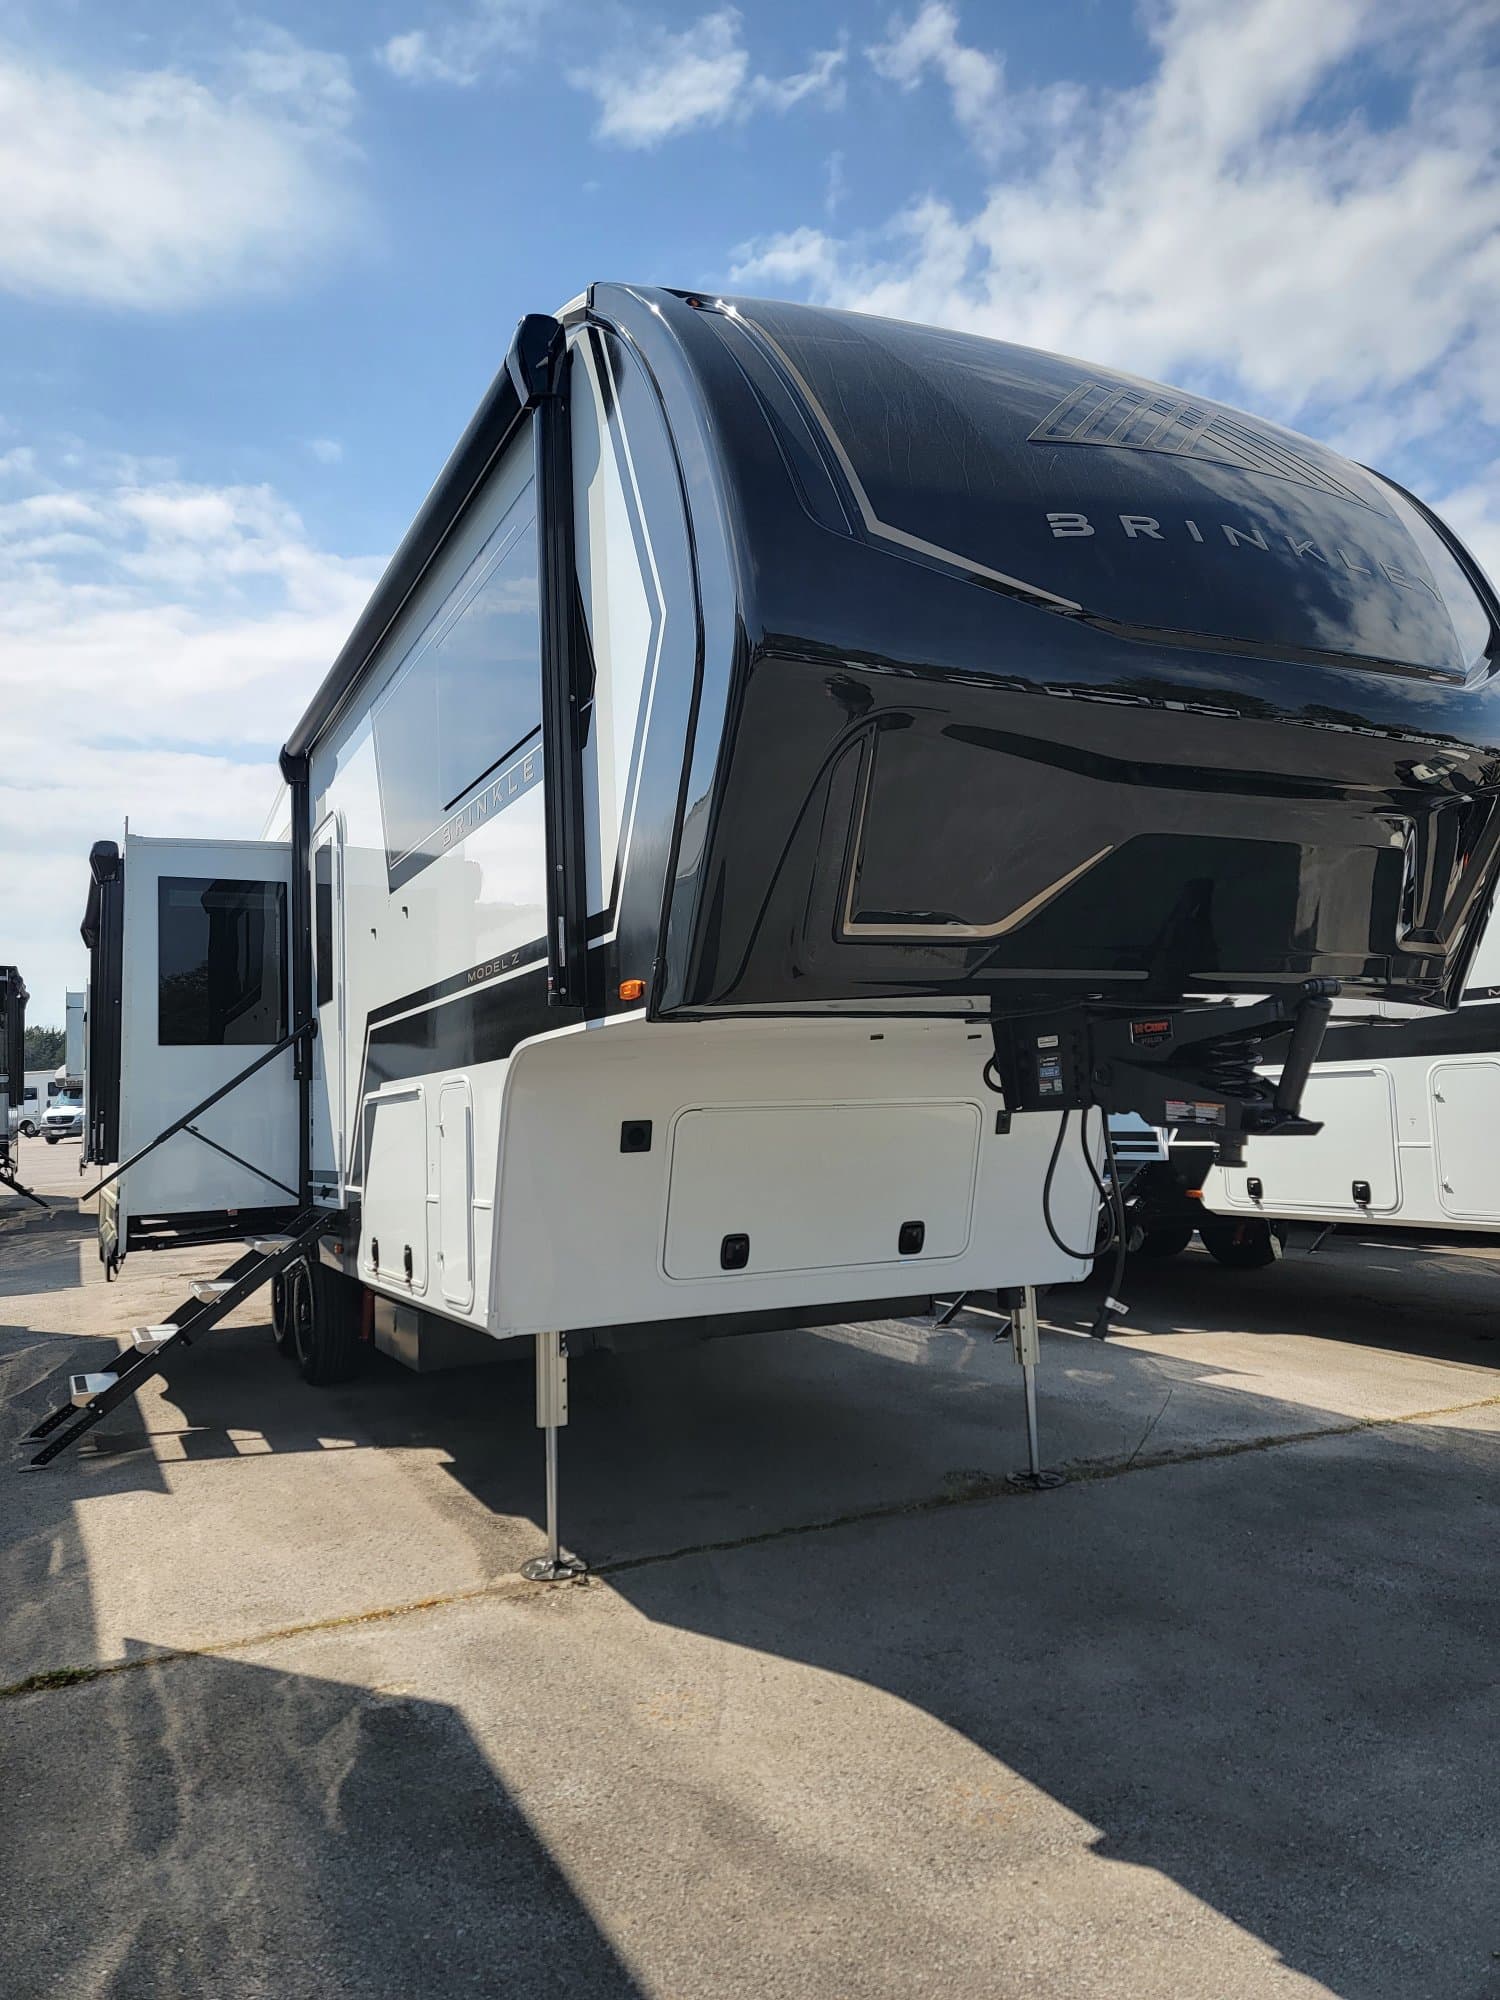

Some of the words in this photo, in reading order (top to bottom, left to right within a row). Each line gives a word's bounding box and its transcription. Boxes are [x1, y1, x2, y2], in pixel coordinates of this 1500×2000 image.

[1046, 512, 1442, 602] BRINKLEY
[443, 746, 544, 848] BRINKLE
[467, 959, 508, 984] MODEL
[511, 951, 520, 966] Z
